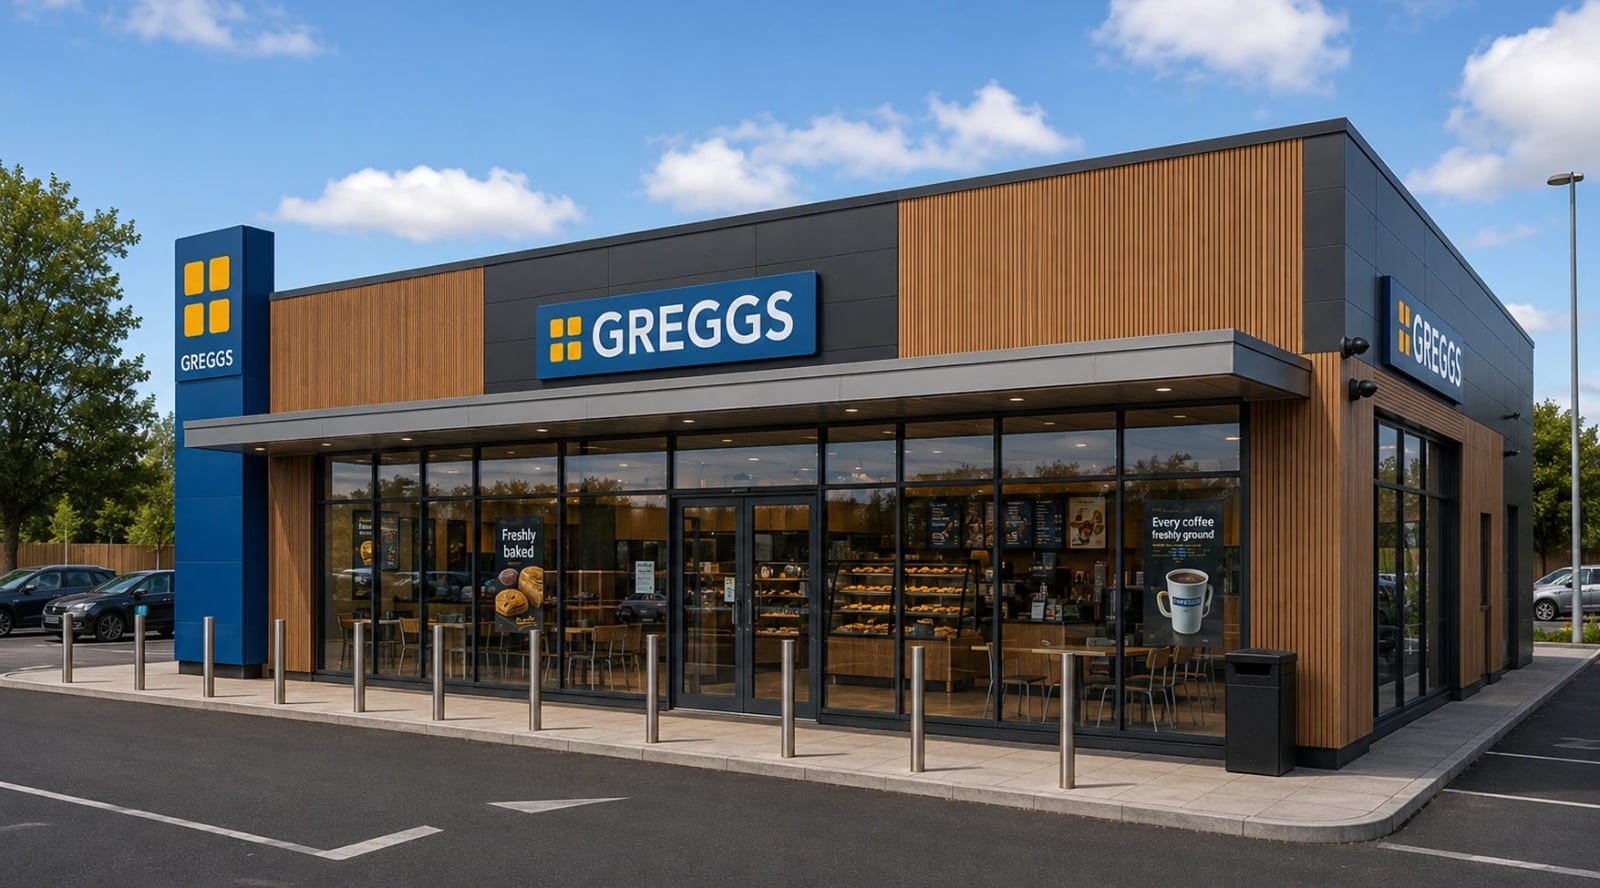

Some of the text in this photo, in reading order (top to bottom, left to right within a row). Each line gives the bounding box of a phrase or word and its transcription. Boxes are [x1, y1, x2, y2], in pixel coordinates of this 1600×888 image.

[592, 290, 794, 358] GREGGS
[1413, 313, 1461, 387] GREGGS
[181, 349, 233, 371] GREGGS
[1152, 516, 1214, 530] Every coffee
[502, 528, 536, 544] Freshly
[1152, 530, 1214, 542] freshly ground
[503, 544, 534, 558] baked
